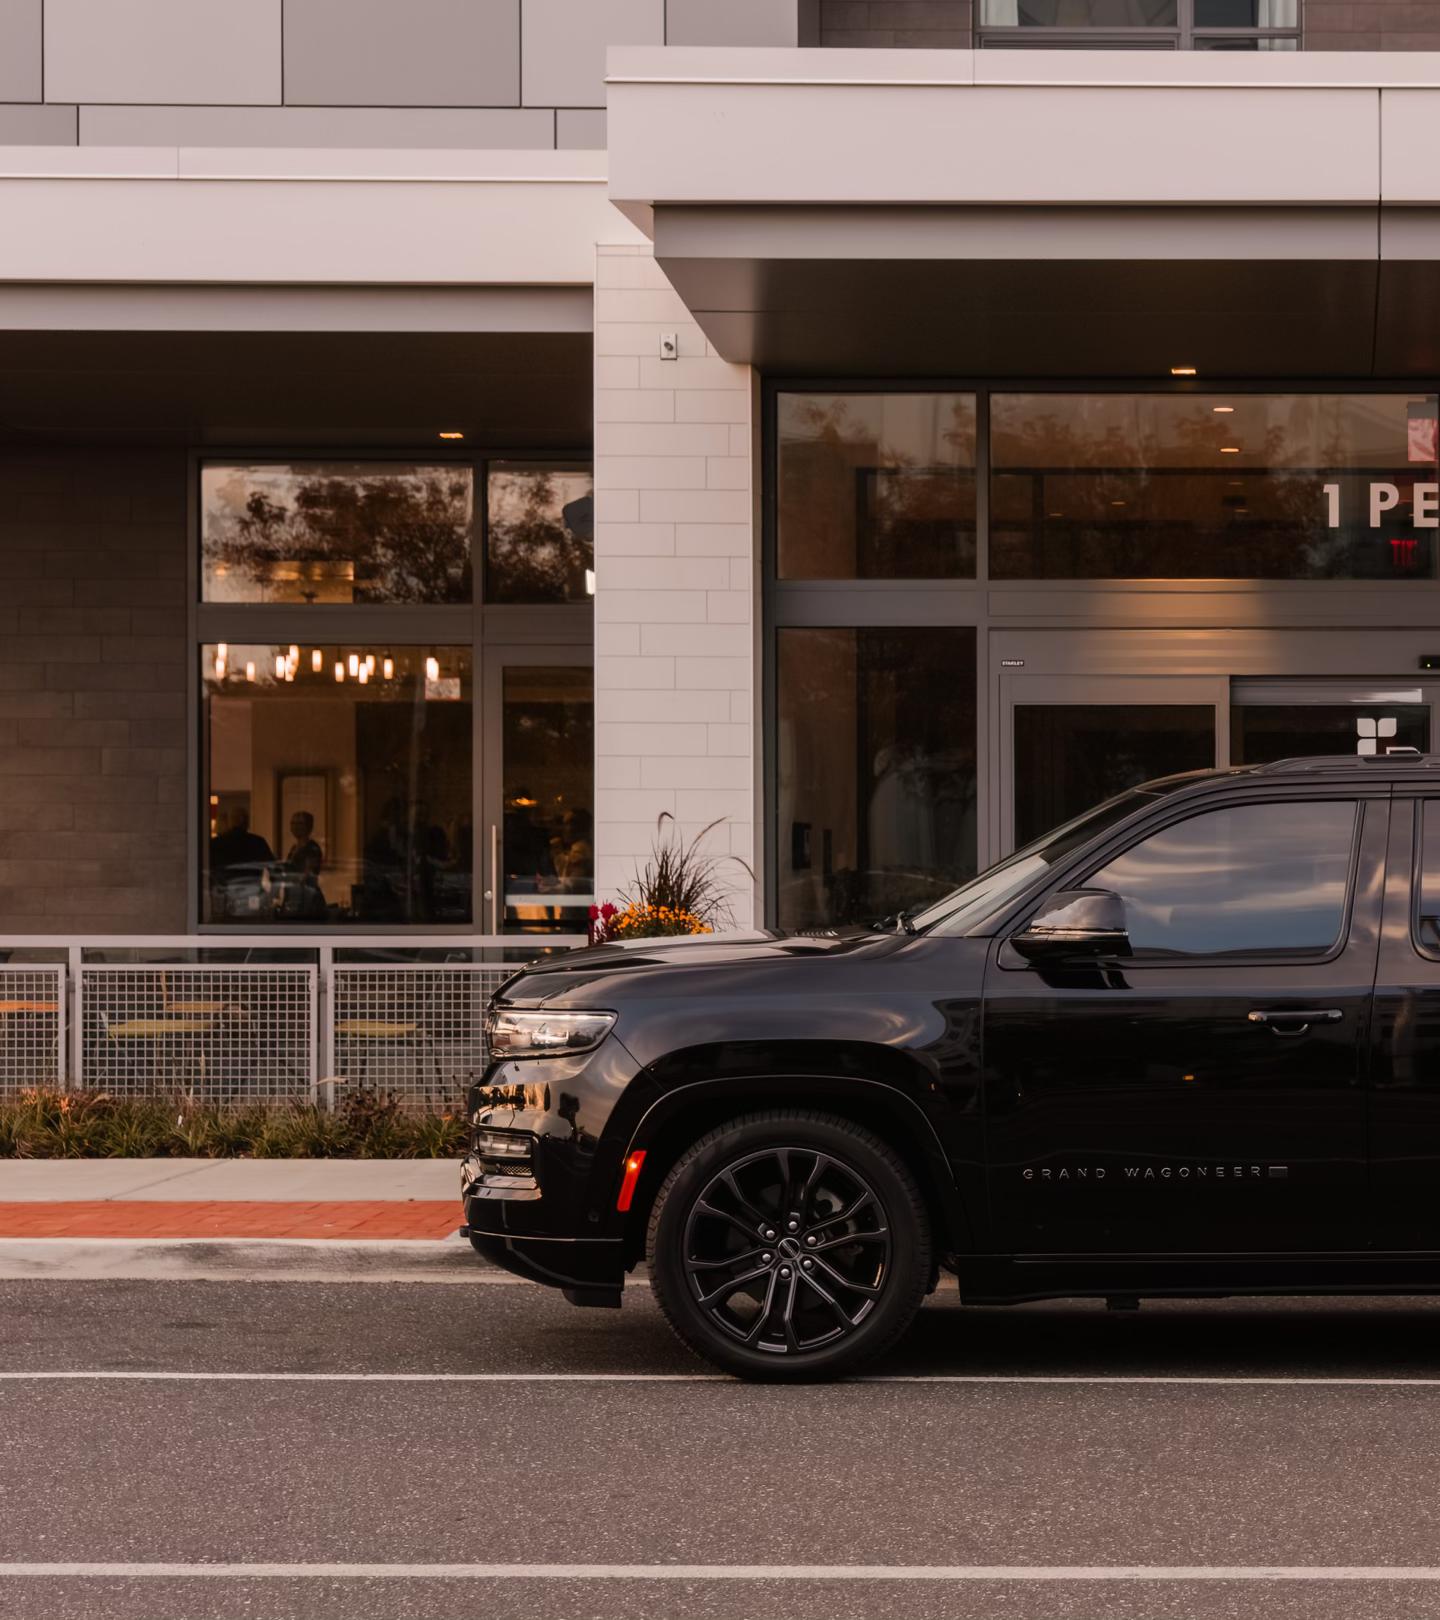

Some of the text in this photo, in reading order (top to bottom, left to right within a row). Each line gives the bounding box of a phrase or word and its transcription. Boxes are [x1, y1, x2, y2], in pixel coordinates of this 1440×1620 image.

[1322, 484, 1340, 528] 1
[1022, 1166, 1262, 1180] GRAND WAGONEER
